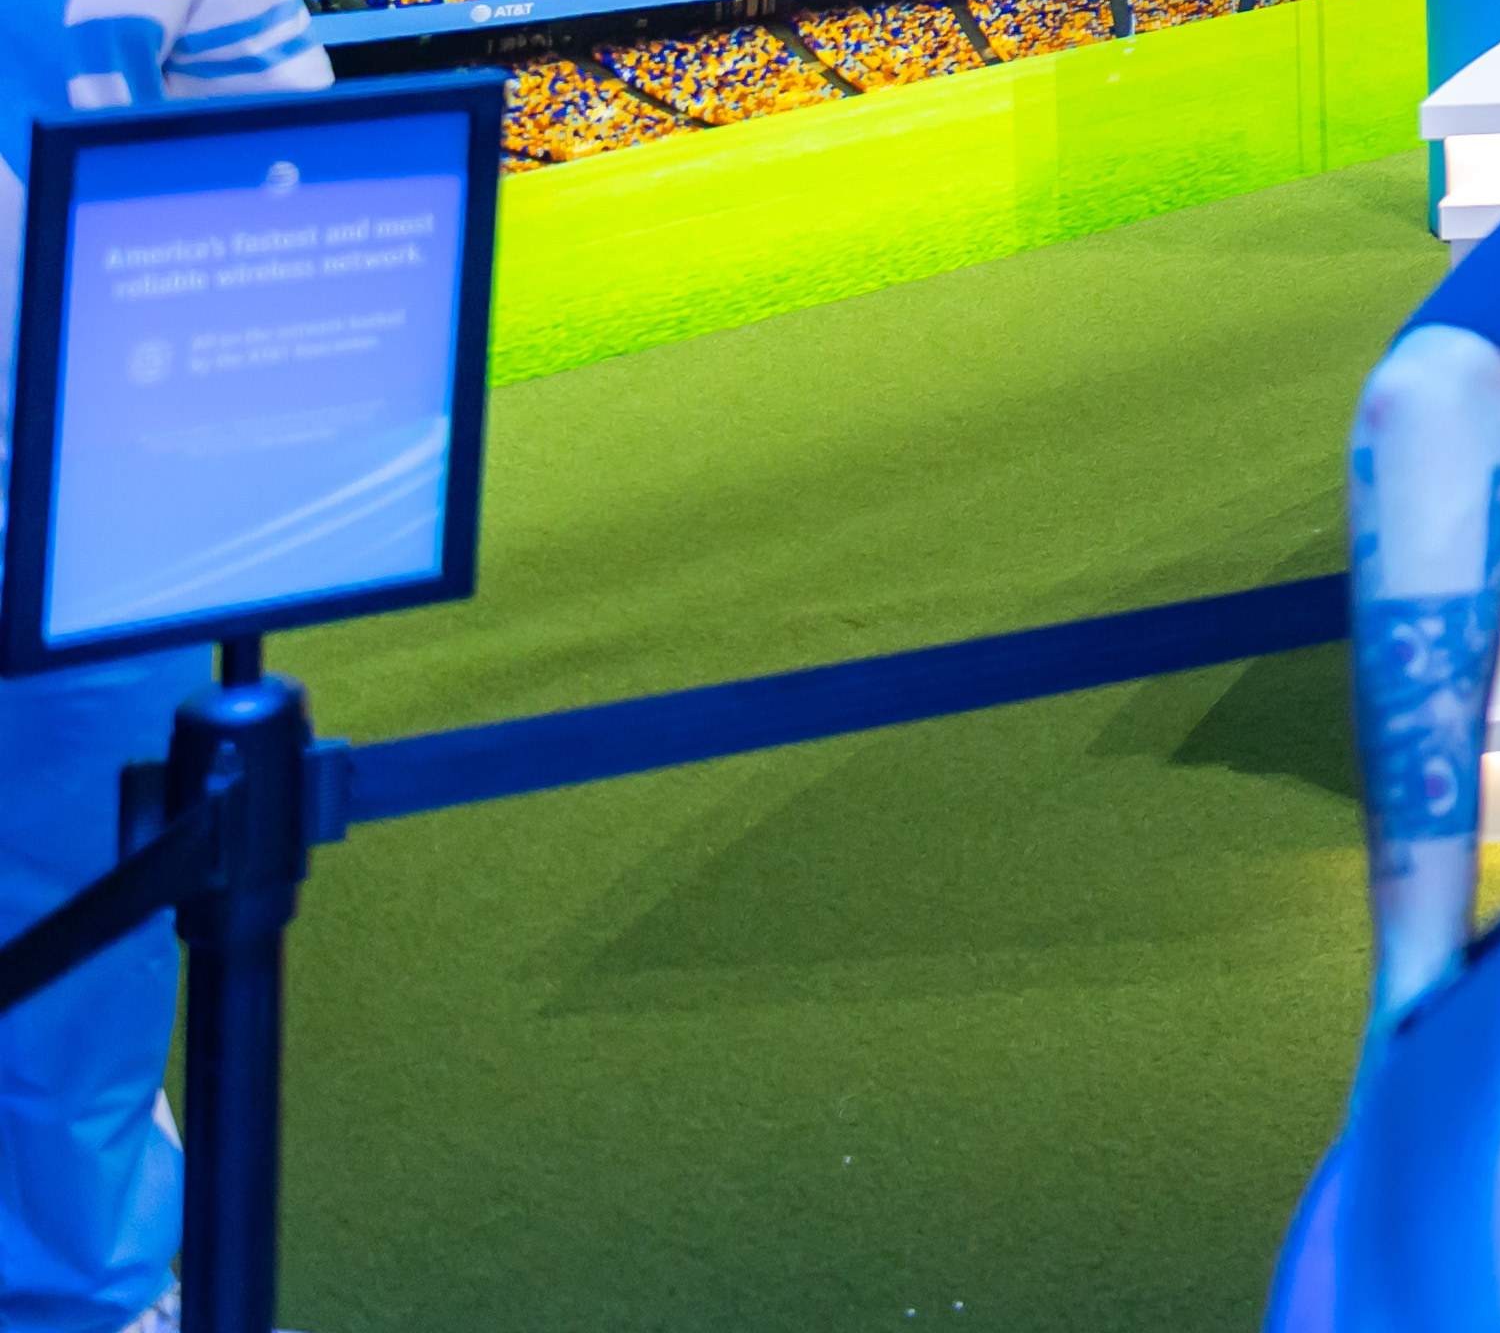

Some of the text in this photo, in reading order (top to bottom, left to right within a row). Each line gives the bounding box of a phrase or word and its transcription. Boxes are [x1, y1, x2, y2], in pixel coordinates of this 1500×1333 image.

[494, 2, 535, 18] AT&T
[106, 213, 434, 270] America's fastest and most
[112, 269, 210, 301] reliable
[215, 257, 316, 289] wireless
